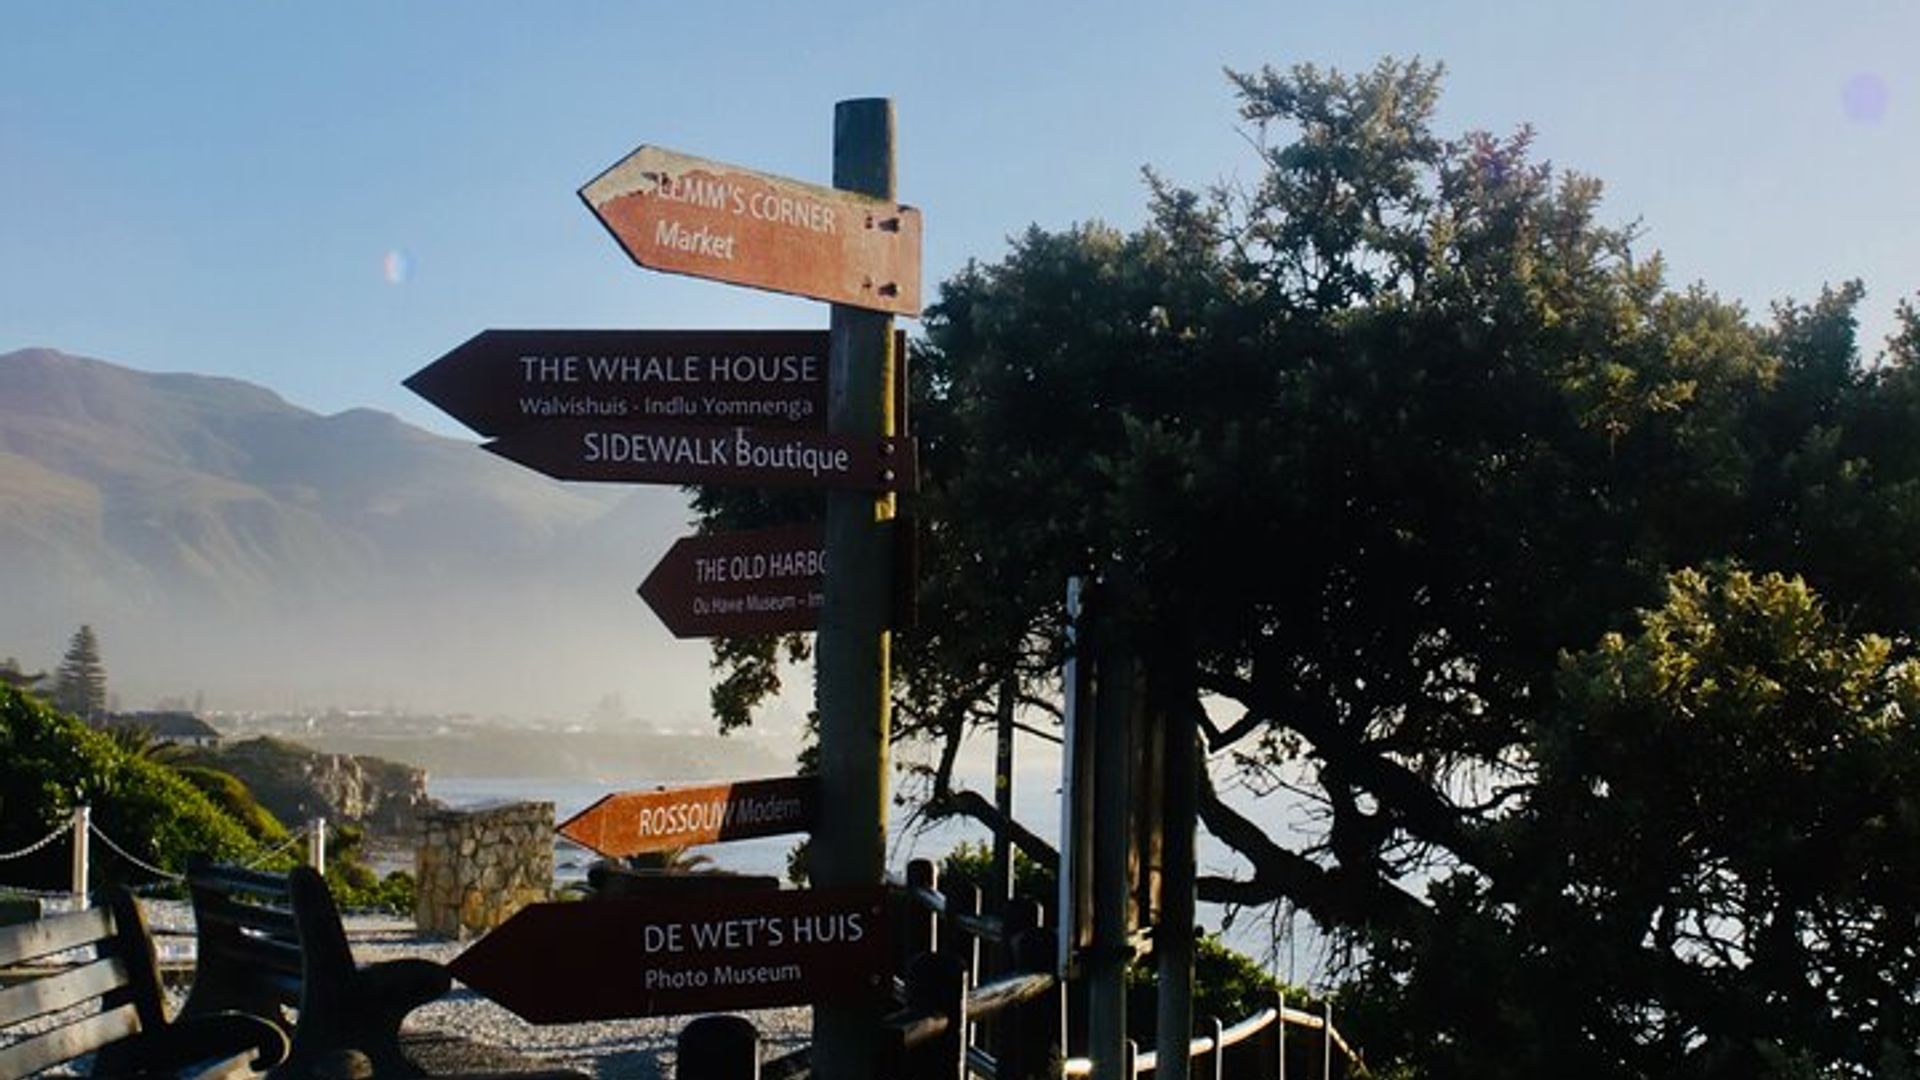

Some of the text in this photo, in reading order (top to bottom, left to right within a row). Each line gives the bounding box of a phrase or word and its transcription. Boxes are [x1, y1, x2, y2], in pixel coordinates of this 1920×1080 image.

[749, 192, 836, 234] CORNER
[655, 219, 735, 260] Market
[521, 356, 818, 382] THE WHALE HOUSE
[519, 396, 627, 416] Walvishuis
[645, 397, 697, 416] Indlu
[704, 398, 813, 421] Yomnenga
[583, 433, 850, 477] SIDEWALK Boutique
[696, 557, 727, 583] THE
[730, 555, 766, 581] OLD
[746, 593, 796, 612] Museum
[639, 797, 731, 836] ROSSOUW
[645, 912, 864, 952] DE WET'S HUIS
[645, 963, 801, 989] Photo Museum
